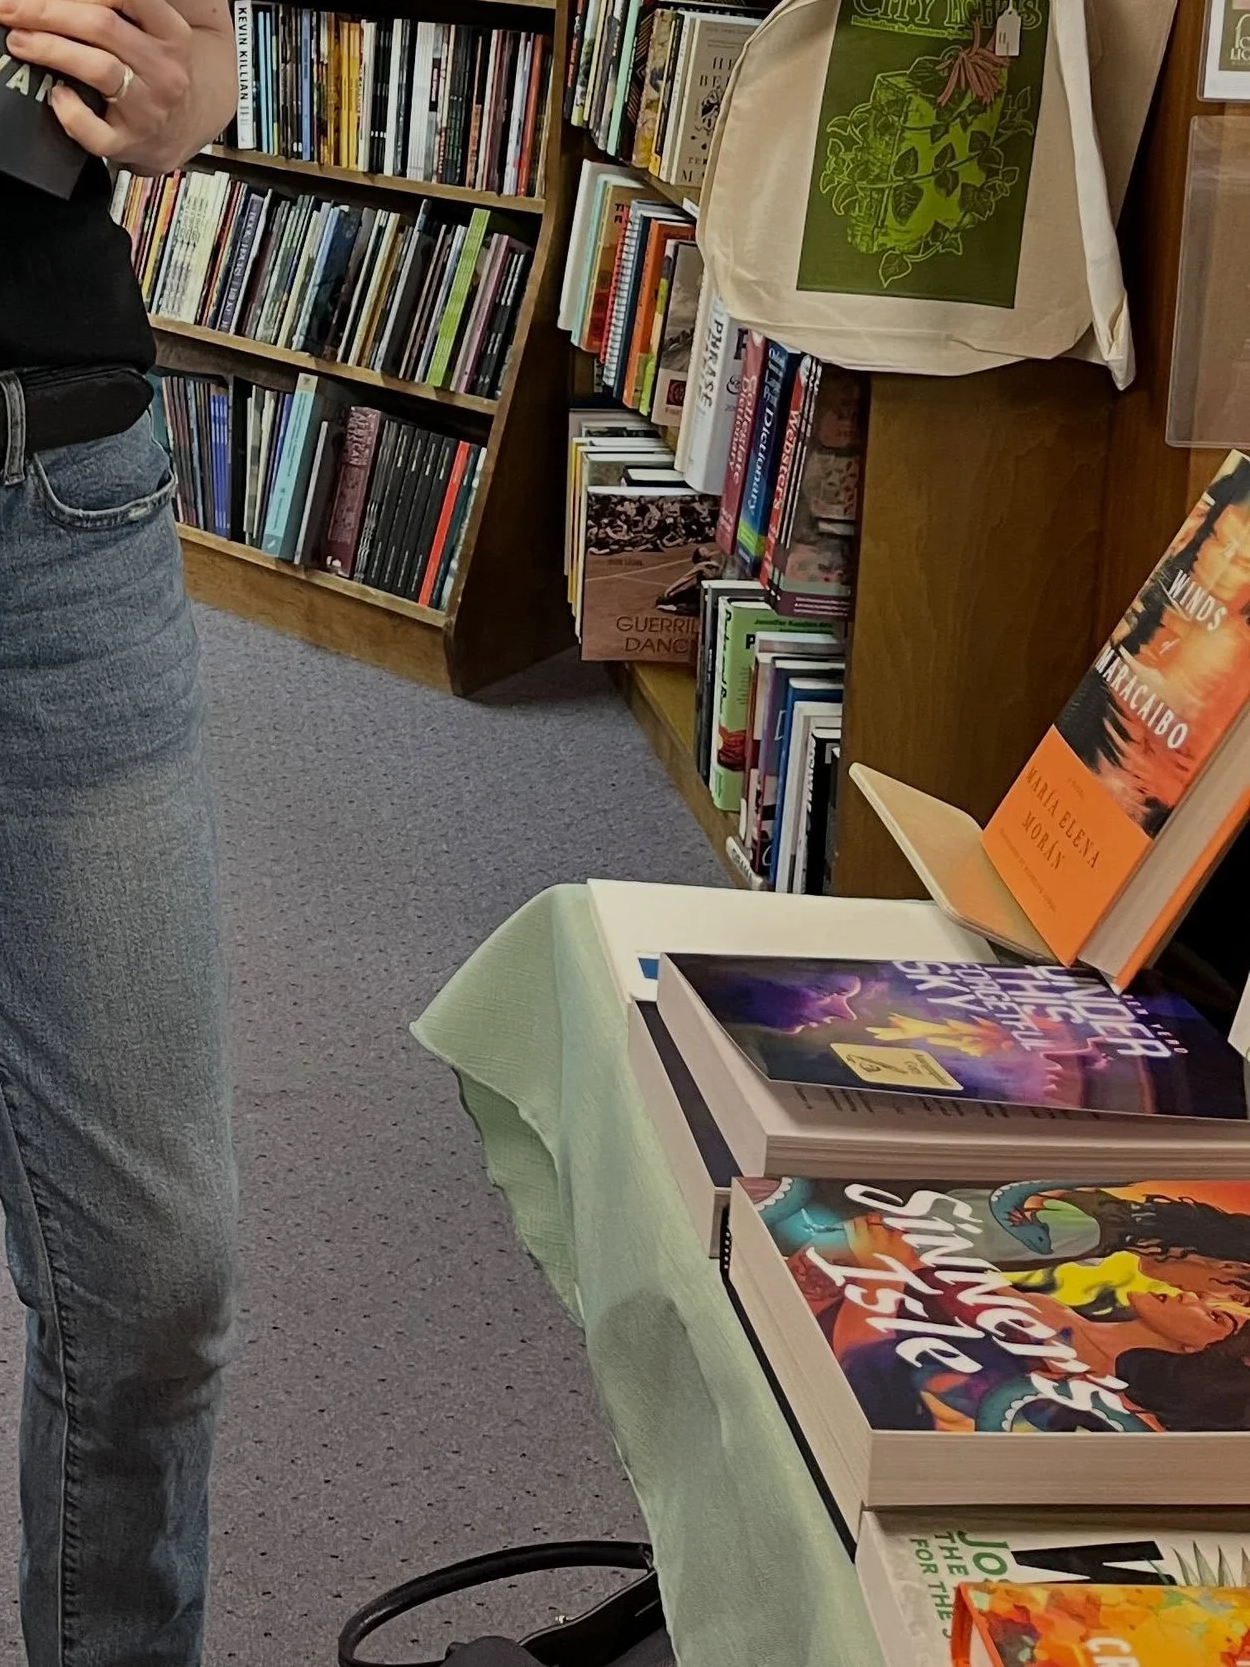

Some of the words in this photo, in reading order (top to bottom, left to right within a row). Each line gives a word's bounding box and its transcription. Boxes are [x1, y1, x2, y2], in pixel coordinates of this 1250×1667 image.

[238, 6, 248, 47] KEVIN
[239, 50, 249, 101] KILLIAN
[701, 319, 724, 409] PHRASE
[736, 375, 760, 485] Collegiate
[748, 408, 774, 515] Dictionary
[1168, 569, 1228, 633] WINDS
[1095, 645, 1188, 750] MARACAIBO
[1058, 808, 1101, 870] ELENA
[893, 960, 985, 1013] SKY
[952, 963, 1043, 1052] FORGETFUL
[983, 964, 1080, 1025] THIS
[1045, 964, 1173, 1059] UNDER
[805, 1246, 986, 1374] Isle
[844, 1183, 1130, 1414] Sinner's
[909, 1537, 939, 1575] FOR
[927, 1581, 952, 1622] THE
[935, 1531, 969, 1578] THE
